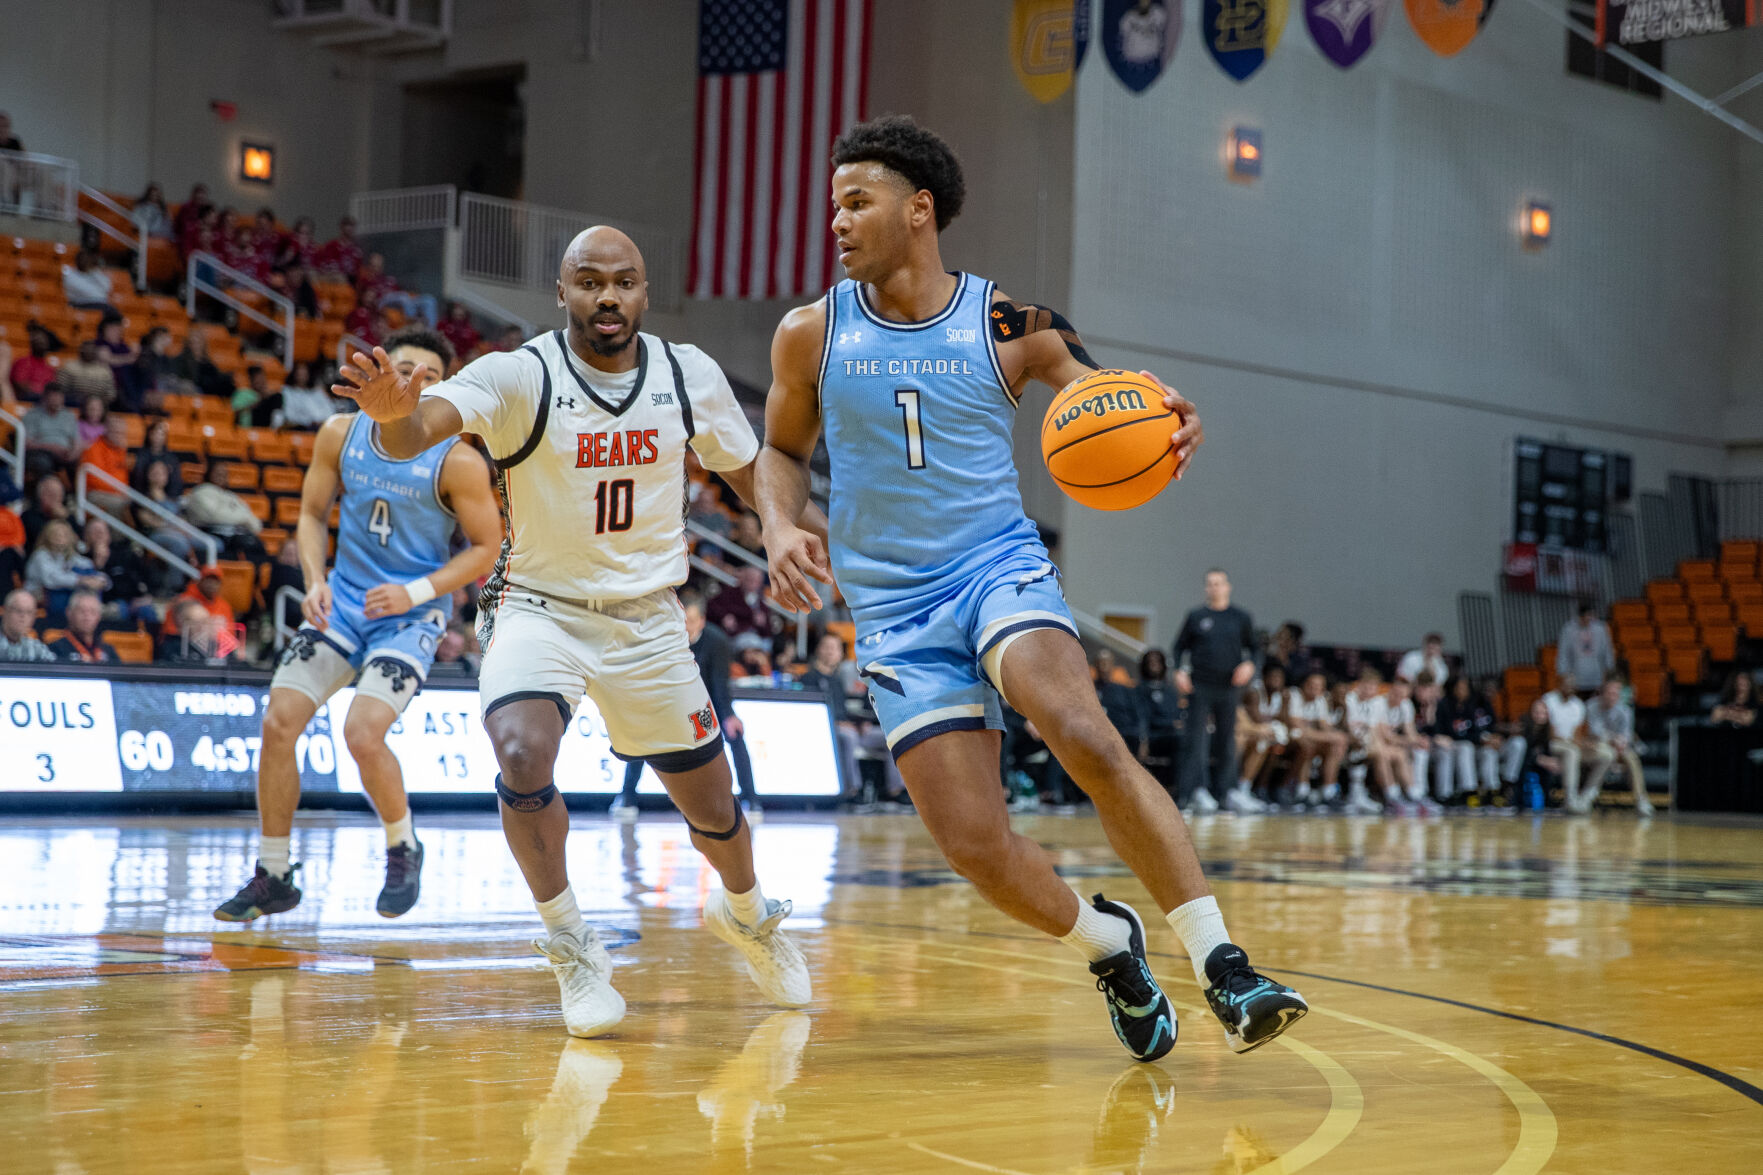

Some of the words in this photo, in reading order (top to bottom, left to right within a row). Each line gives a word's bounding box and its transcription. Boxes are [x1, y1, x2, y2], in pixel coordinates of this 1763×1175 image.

[1619, 11, 1731, 45] REGIONAL
[843, 359, 881, 376] THE
[887, 359, 974, 376] CITADEL
[1054, 389, 1148, 432] Wilson
[894, 389, 926, 470] 1
[575, 429, 659, 468] BEARS
[350, 469, 369, 485] THE
[373, 477, 421, 499] CITADEL
[594, 478, 635, 535] 10
[368, 497, 393, 548] 4
[0, 701, 94, 729] OULS
[174, 691, 256, 717] PERIOD
[424, 712, 469, 735] AST
[119, 729, 174, 771] 60
[36, 753, 55, 782] 3
[438, 754, 469, 778] 13
[600, 758, 613, 782] 5
